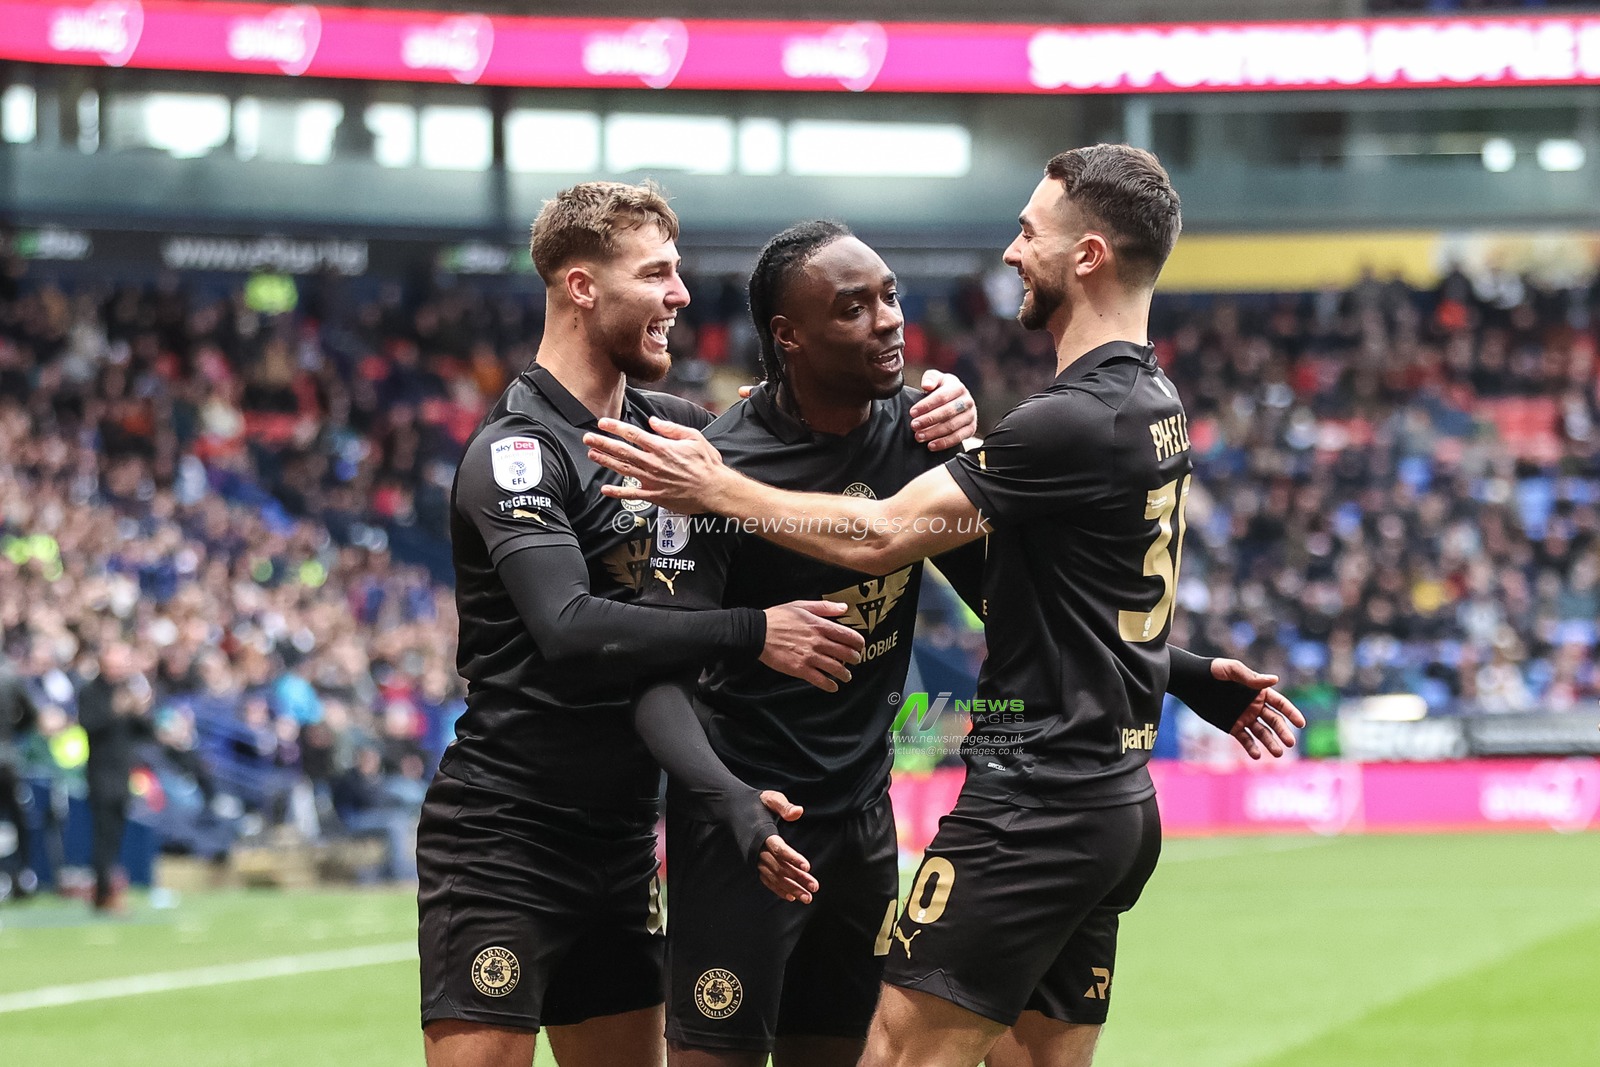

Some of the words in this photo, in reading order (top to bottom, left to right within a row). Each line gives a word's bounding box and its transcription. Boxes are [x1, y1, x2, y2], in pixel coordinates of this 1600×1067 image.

[495, 444, 511, 454] sky
[514, 441, 535, 450] bet
[512, 477, 527, 486] EFL
[661, 539, 675, 549] EFL
[476, 949, 519, 970] BARNSLEY
[474, 971, 501, 995] FOOTBALL
[501, 978, 516, 993] CLUB
[699, 970, 741, 991] BARNSLEY
[696, 994, 723, 1017] FOOTBALL
[723, 999, 739, 1015] CLUB
